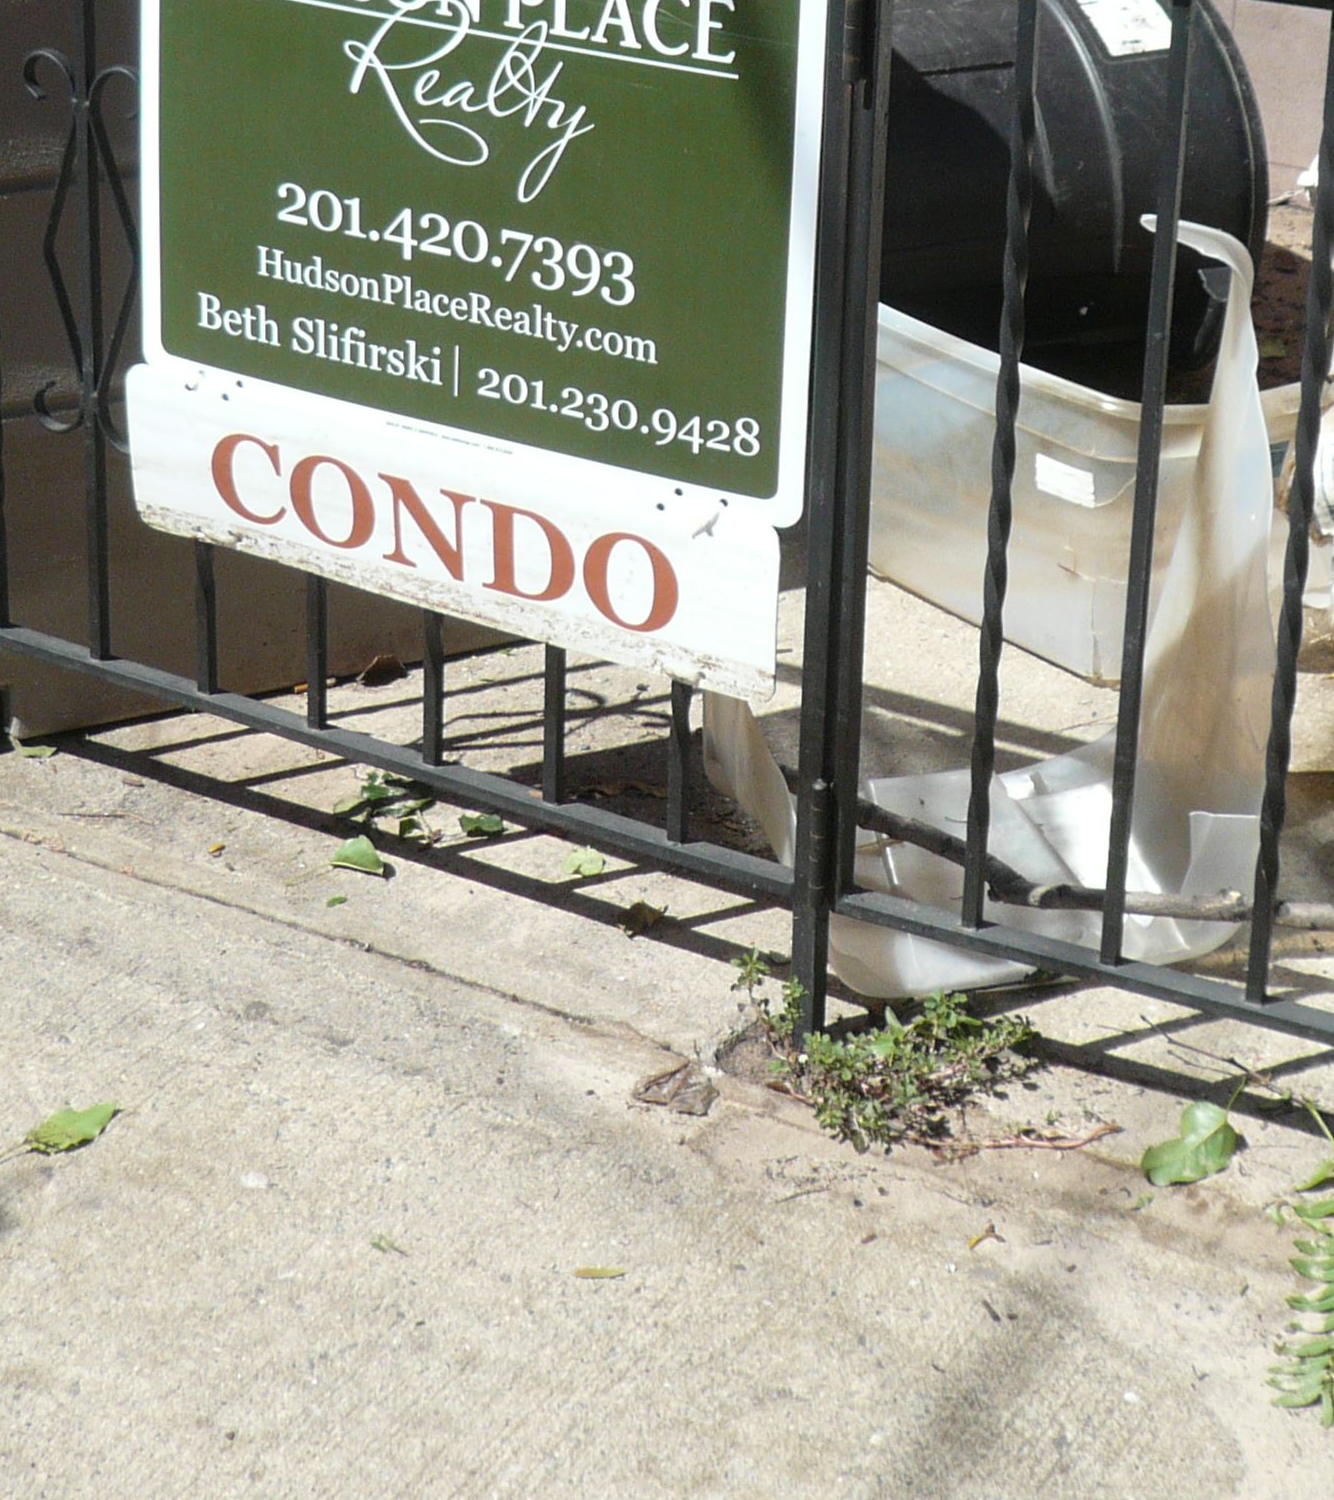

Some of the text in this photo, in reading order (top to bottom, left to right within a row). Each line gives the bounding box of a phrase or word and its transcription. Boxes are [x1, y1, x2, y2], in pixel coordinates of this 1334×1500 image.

[256, 245, 659, 364] HudsonPlaceRealty.com
[276, 182, 637, 307] 201.420.7393
[197, 292, 280, 347] Beth
[291, 317, 443, 386] Slifirski
[476, 367, 762, 458] 201.230.9428
[210, 432, 680, 633] CONDO
